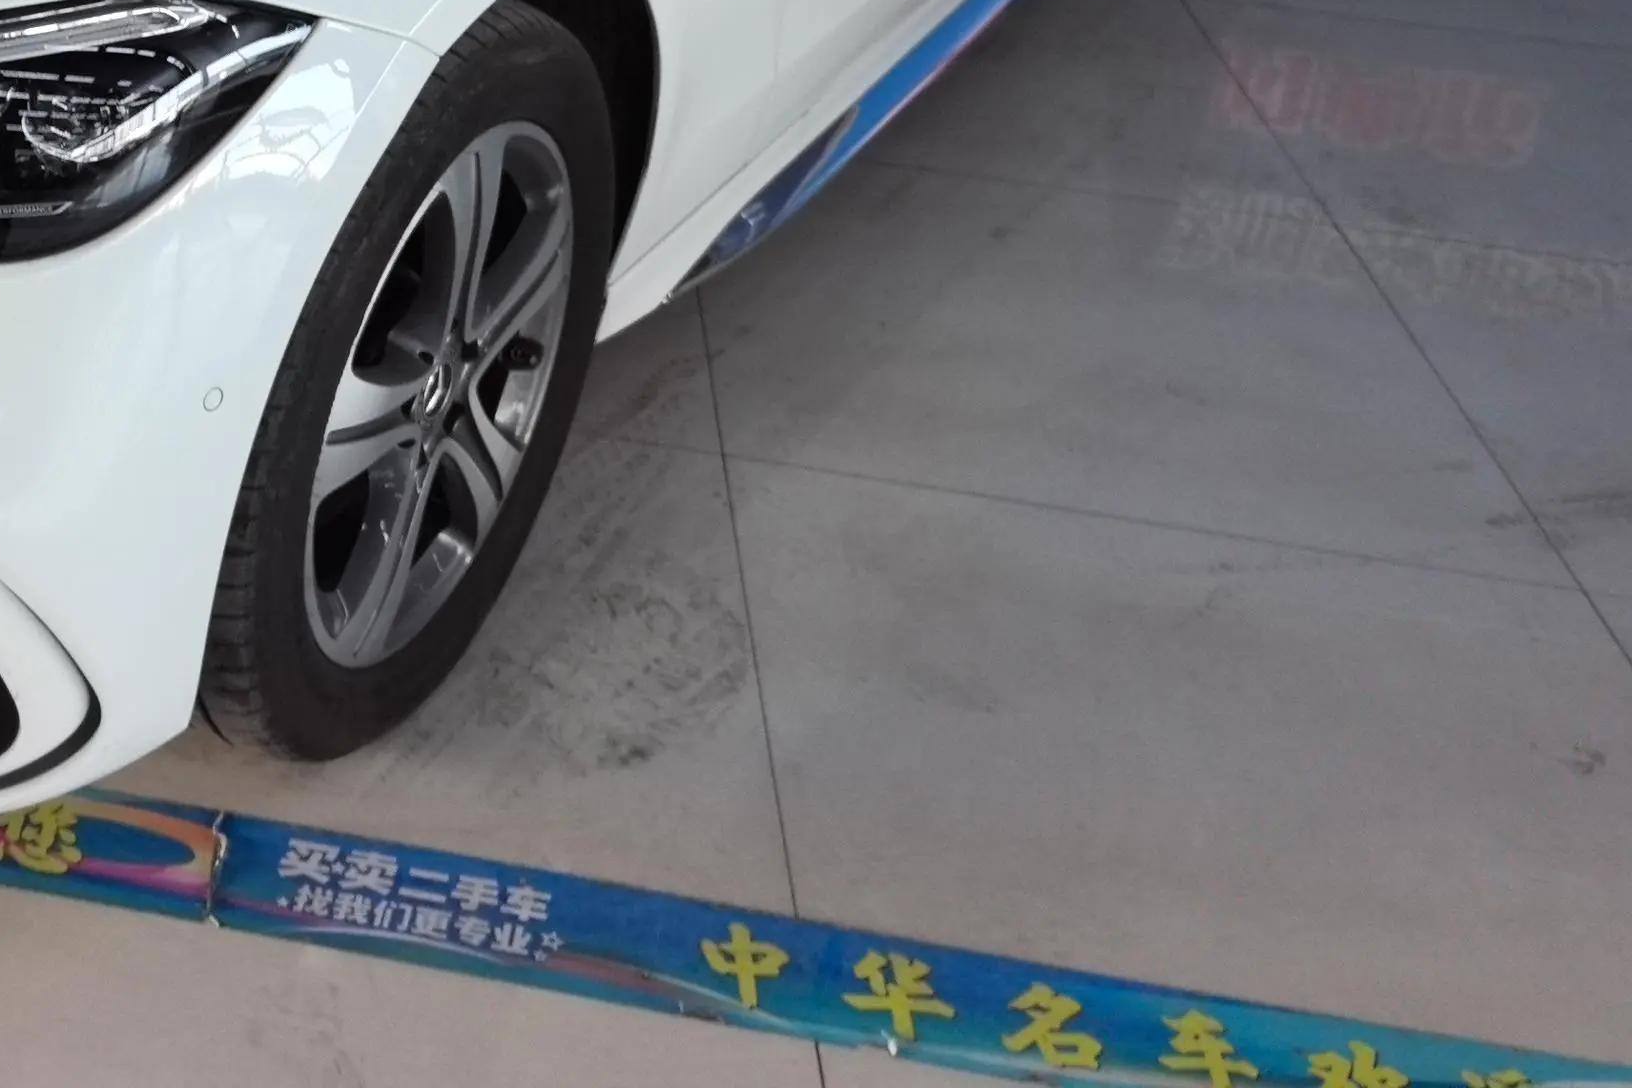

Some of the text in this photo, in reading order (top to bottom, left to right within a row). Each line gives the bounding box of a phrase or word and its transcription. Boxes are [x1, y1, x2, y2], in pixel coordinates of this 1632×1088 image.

[278, 837, 552, 922] 买卖二手车
[292, 883, 533, 957] 找我们更专业
